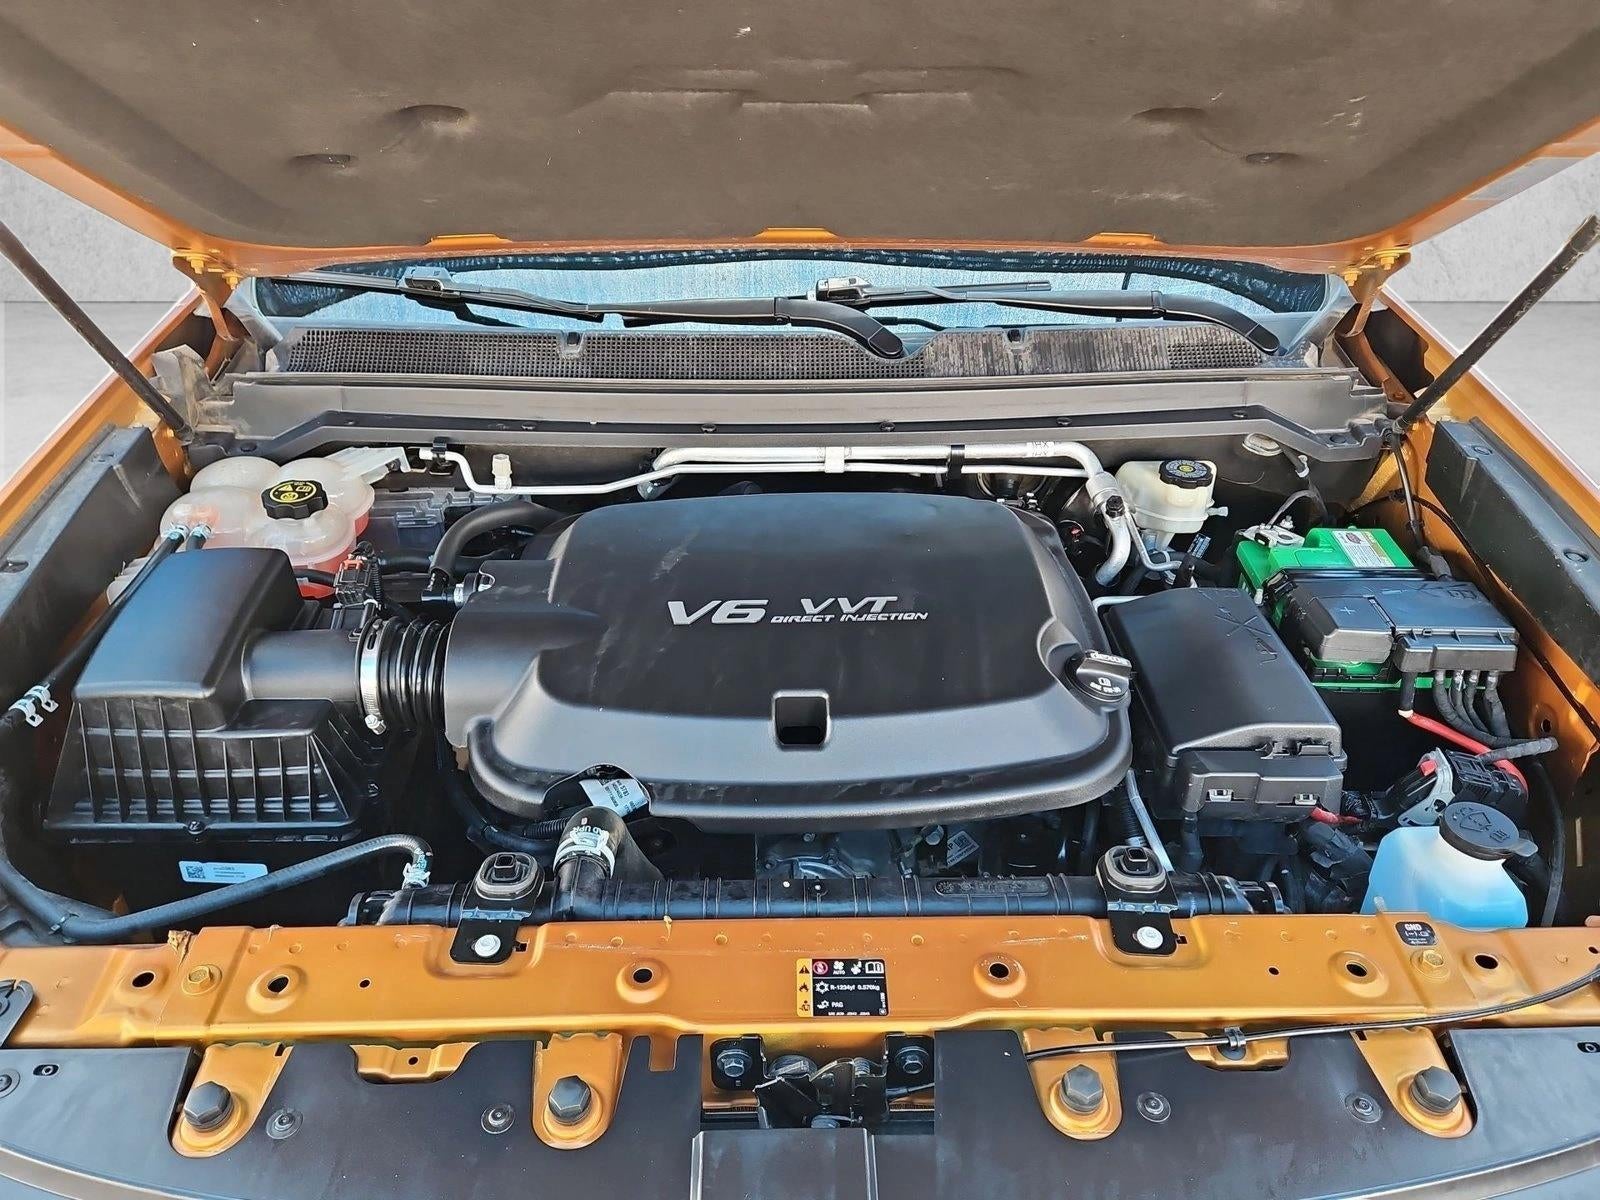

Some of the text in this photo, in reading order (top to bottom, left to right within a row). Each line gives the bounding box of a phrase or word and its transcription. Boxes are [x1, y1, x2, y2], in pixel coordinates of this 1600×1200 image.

[667, 599, 769, 625] V6
[800, 596, 898, 614] VVT
[770, 612, 929, 623] DIRECT INJECTION
[1404, 923, 1423, 931] GND
